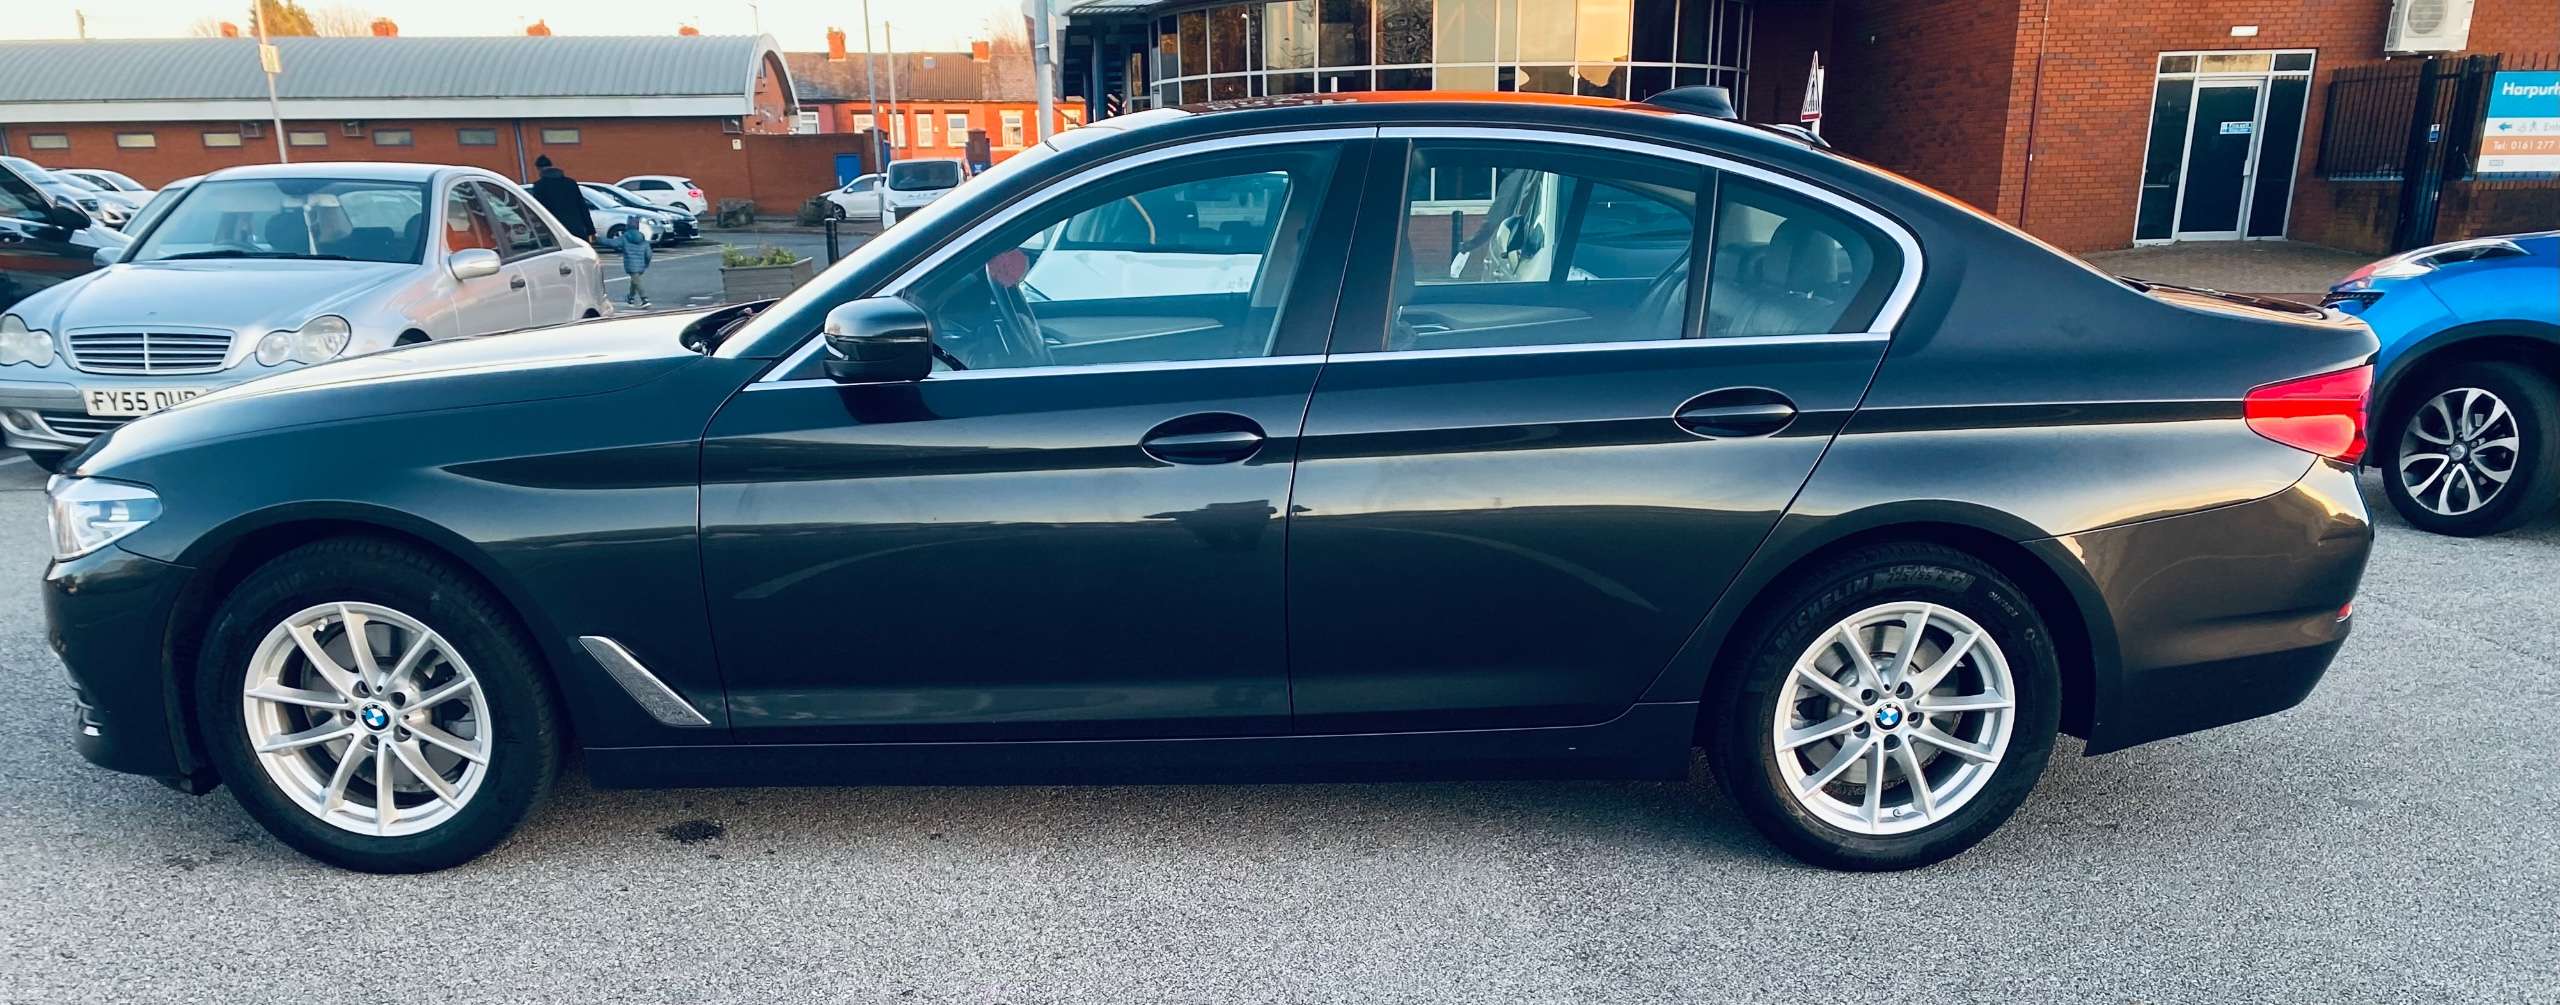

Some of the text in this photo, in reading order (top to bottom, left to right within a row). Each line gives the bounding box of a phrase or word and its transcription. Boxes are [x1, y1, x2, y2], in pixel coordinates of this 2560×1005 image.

[2511, 140, 2533, 150] 0161
[2536, 140, 2555, 150] 277
[93, 391, 149, 411] FY55
[1775, 576, 1869, 649] MICHELIN
